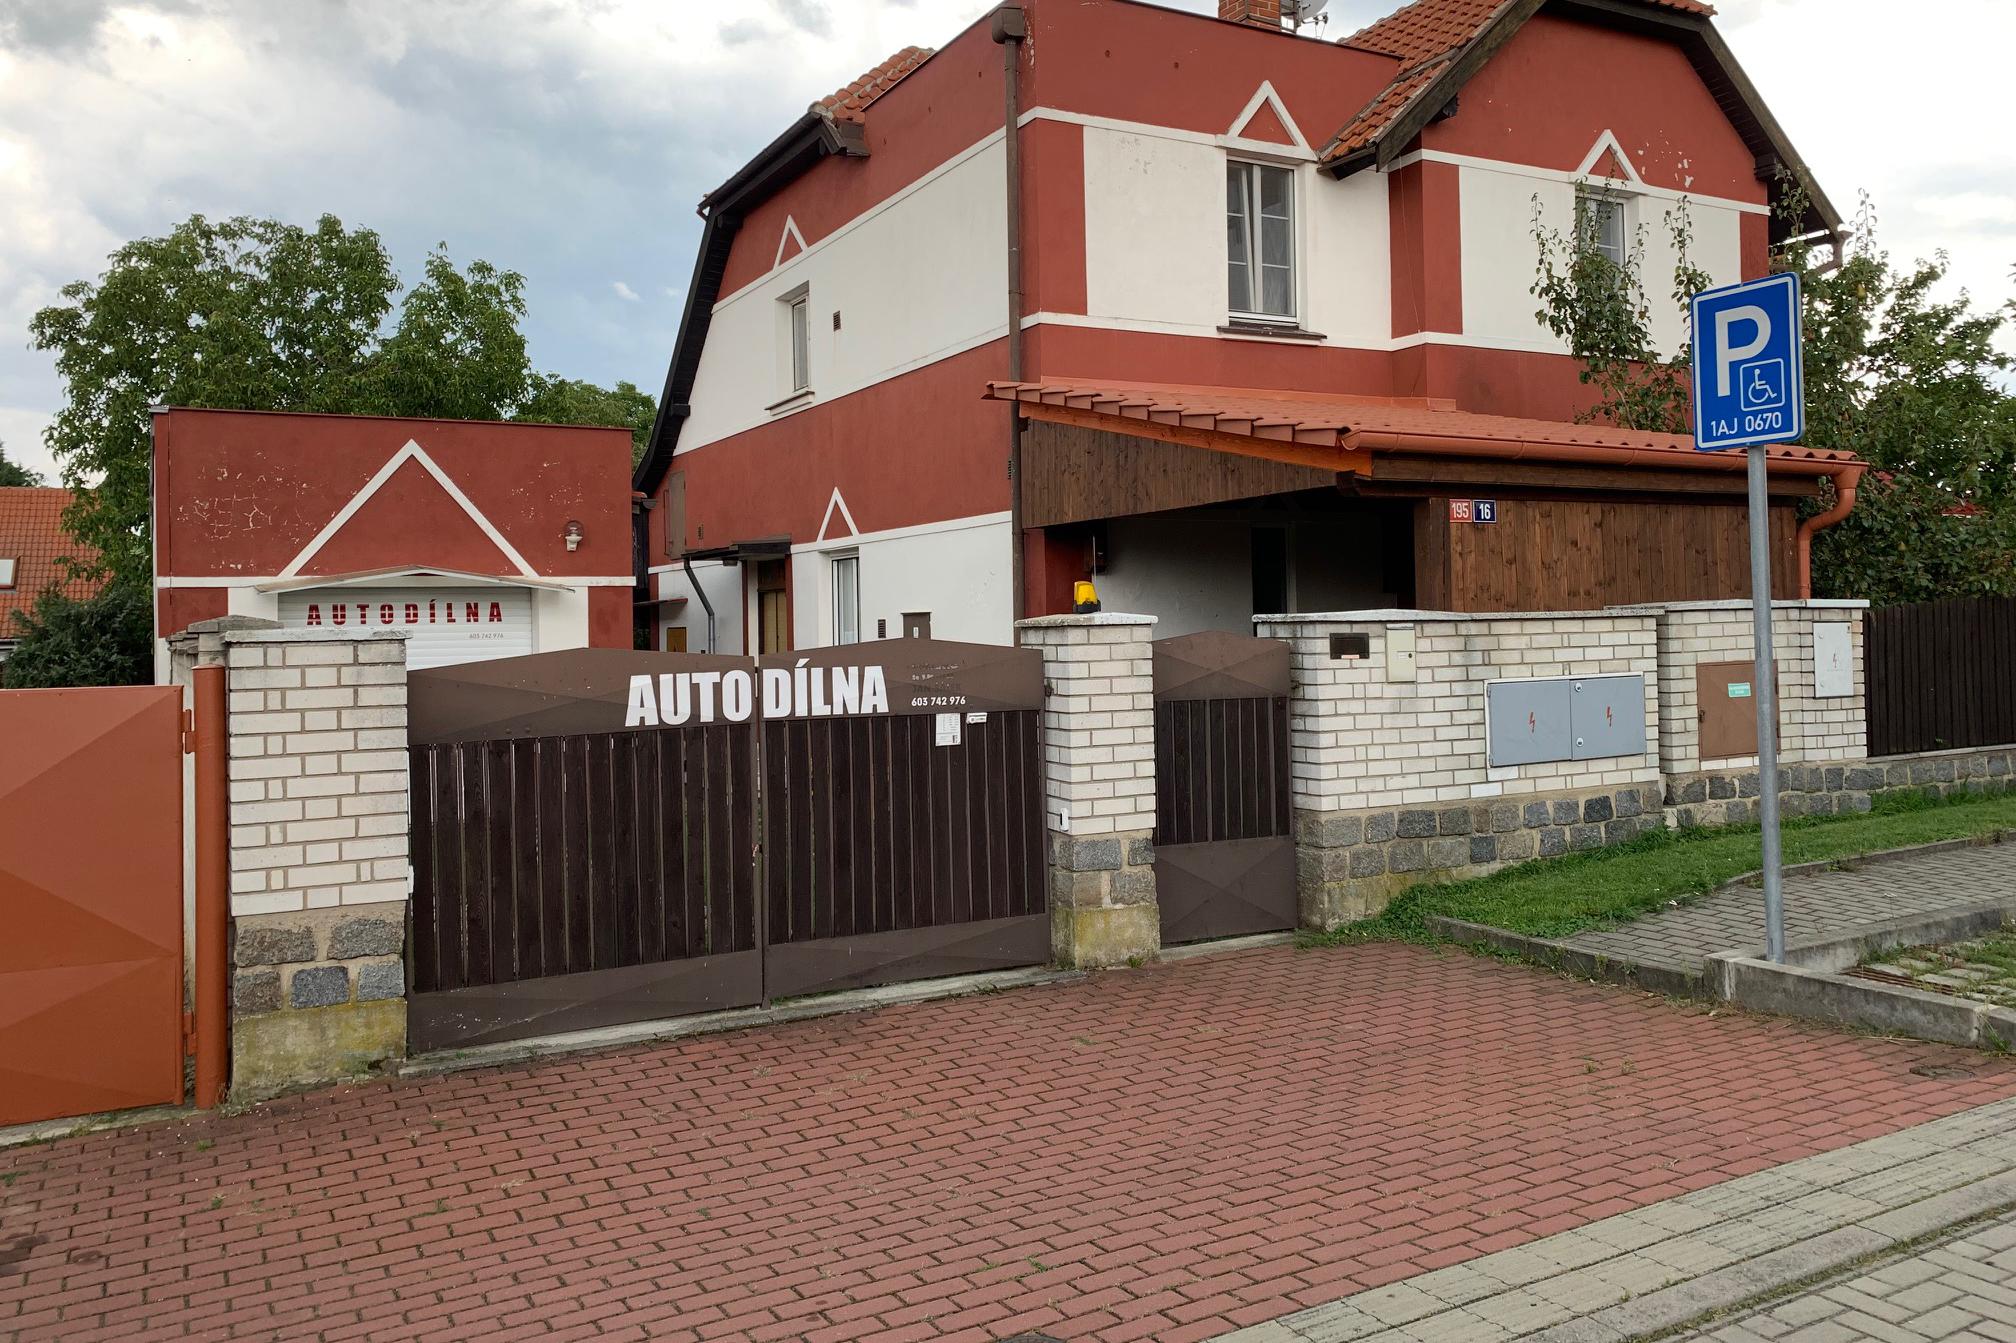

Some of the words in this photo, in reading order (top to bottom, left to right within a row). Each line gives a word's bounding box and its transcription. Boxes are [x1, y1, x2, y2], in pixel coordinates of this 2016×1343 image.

[1715, 305, 1772, 397] P
[1710, 417, 1738, 437] 1AJ
[1745, 411, 1782, 433] 0670
[1451, 502, 1469, 518] 195
[1479, 503, 1491, 520] 16
[306, 599, 503, 626] AUTODÍLNA
[911, 697, 928, 707] 603
[930, 696, 947, 706] 742
[949, 695, 966, 705] 976
